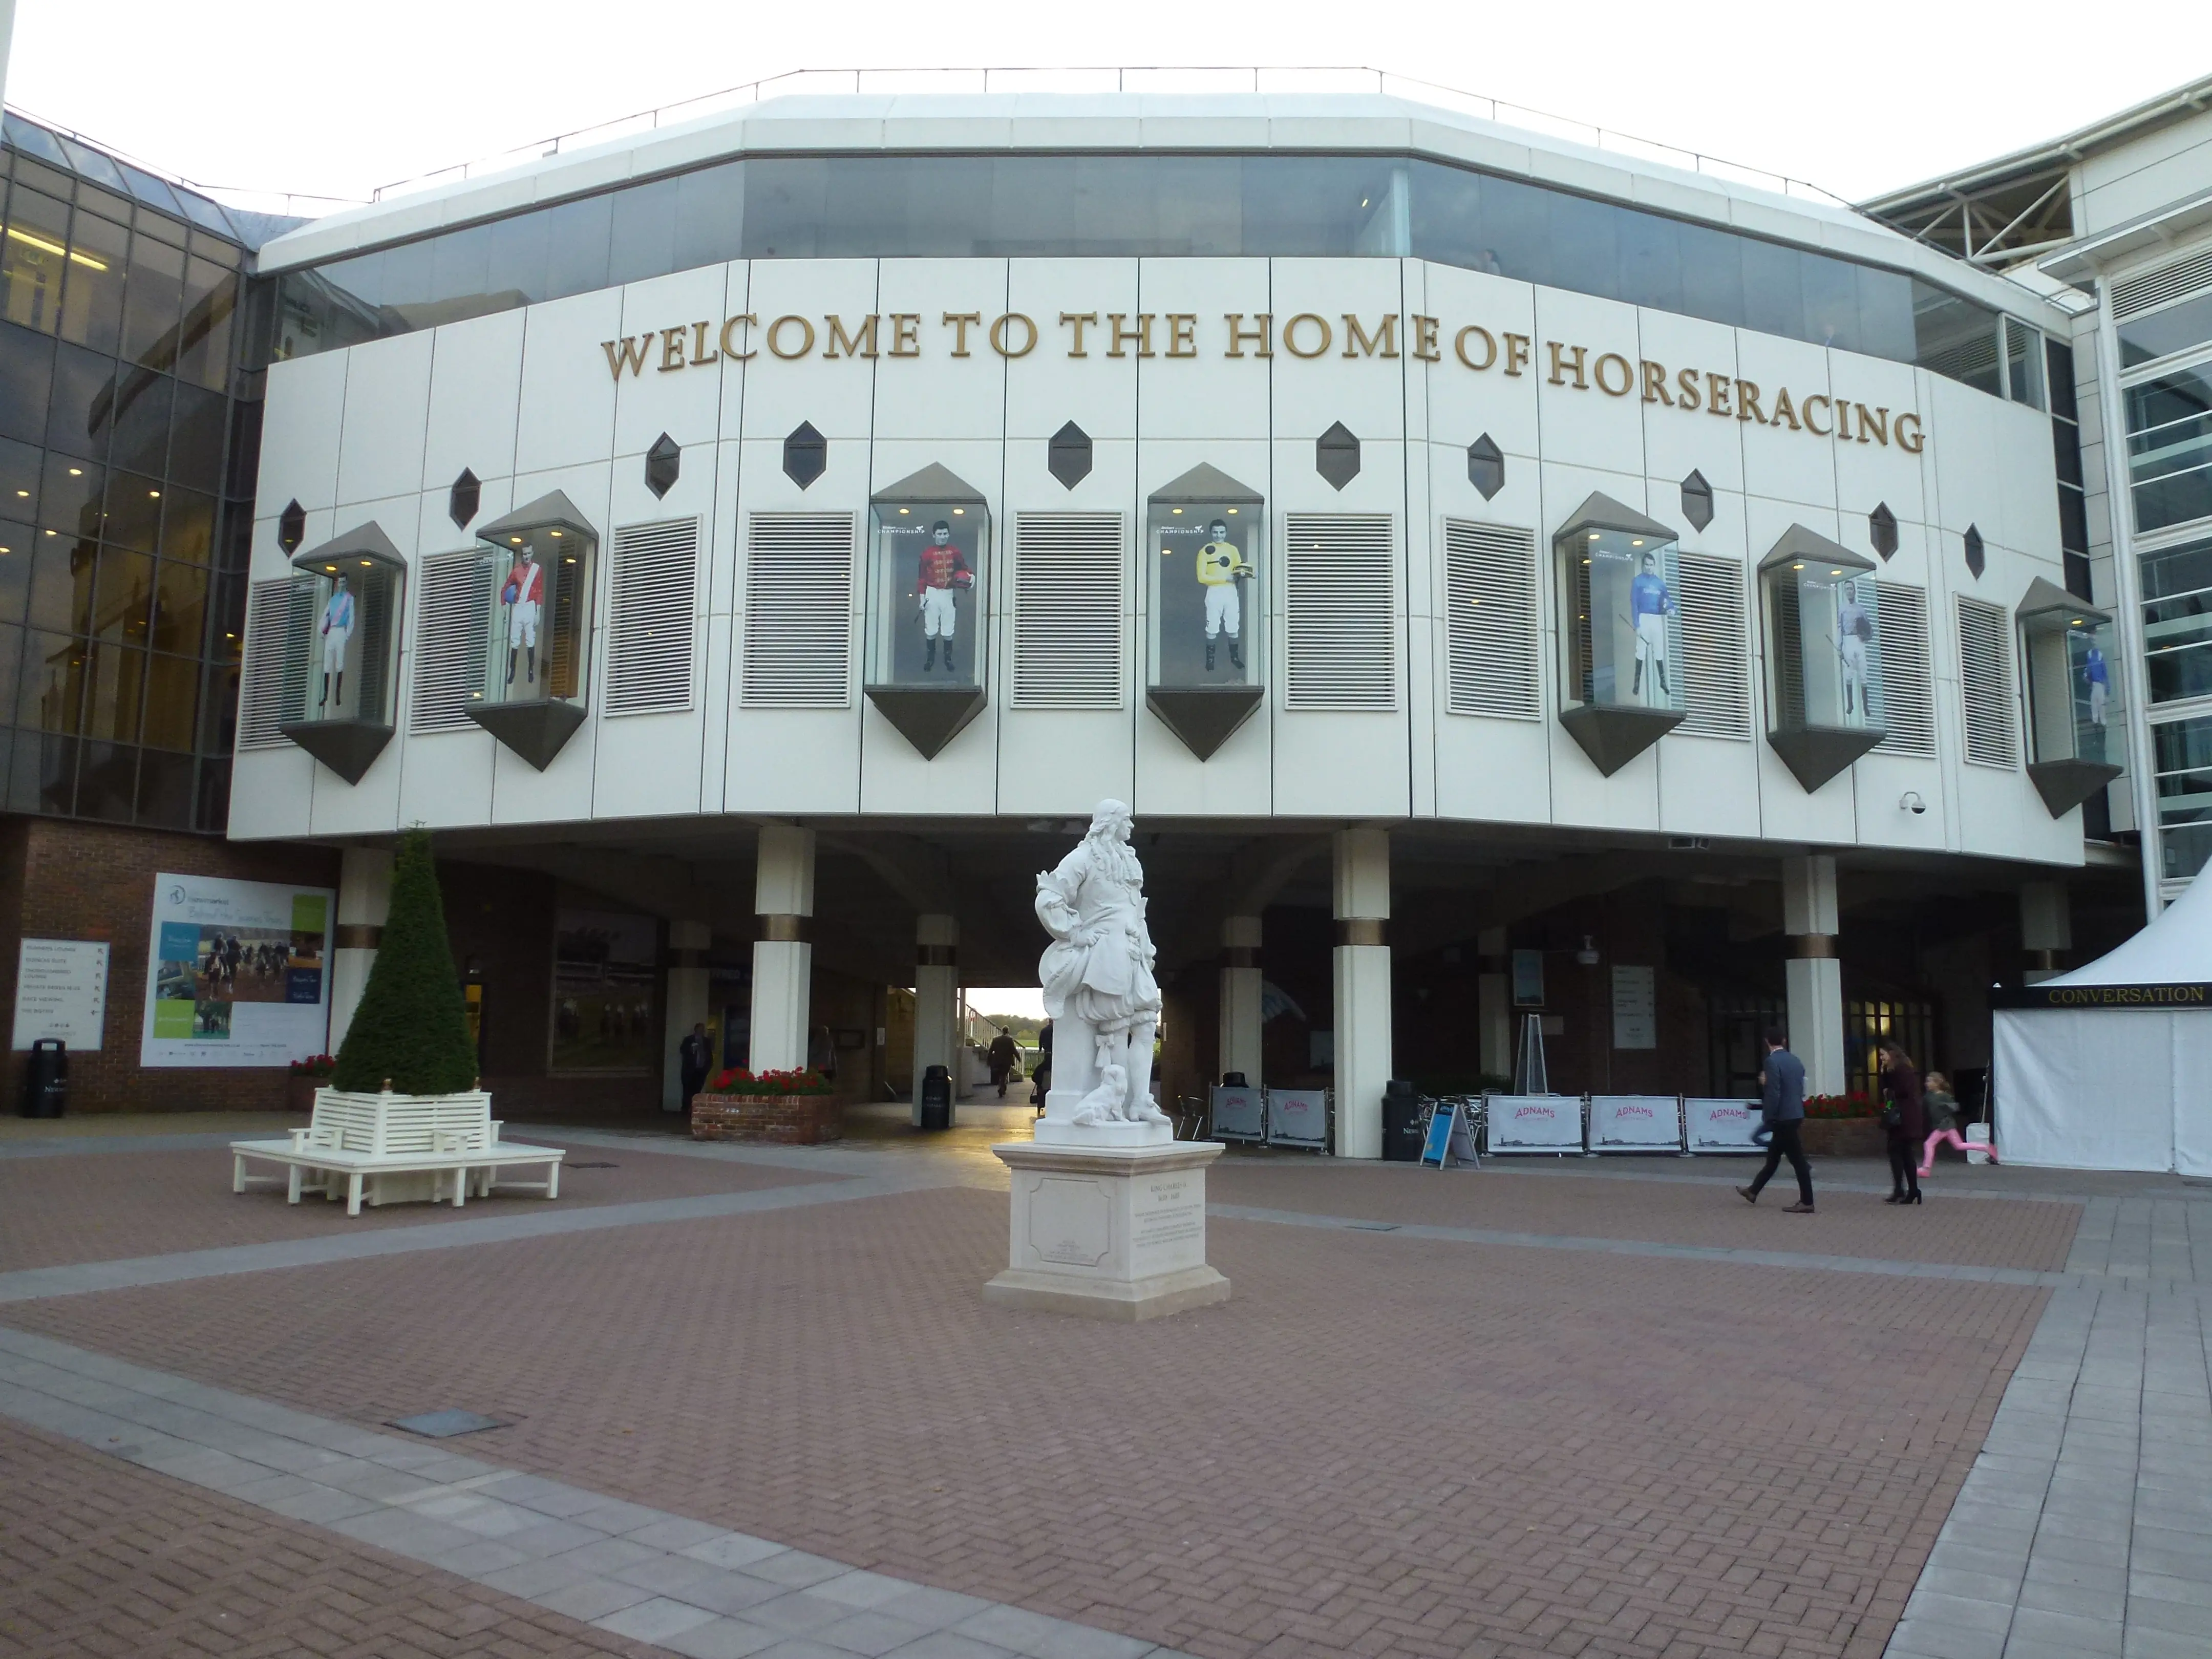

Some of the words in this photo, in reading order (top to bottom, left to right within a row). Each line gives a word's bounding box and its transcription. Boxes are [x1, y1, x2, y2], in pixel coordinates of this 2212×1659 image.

[600, 312, 921, 381] WELCOME
[942, 310, 1038, 358] TO
[1059, 310, 1198, 358] THE
[1223, 312, 1441, 361] HOME
[1454, 324, 1530, 376] OF
[1546, 340, 1926, 453] HORSERACING
[2048, 987, 2204, 1004] CONVERSATION
[1514, 1105, 1556, 1119] ADNAMS
[1615, 1105, 1653, 1118] ADNAMS
